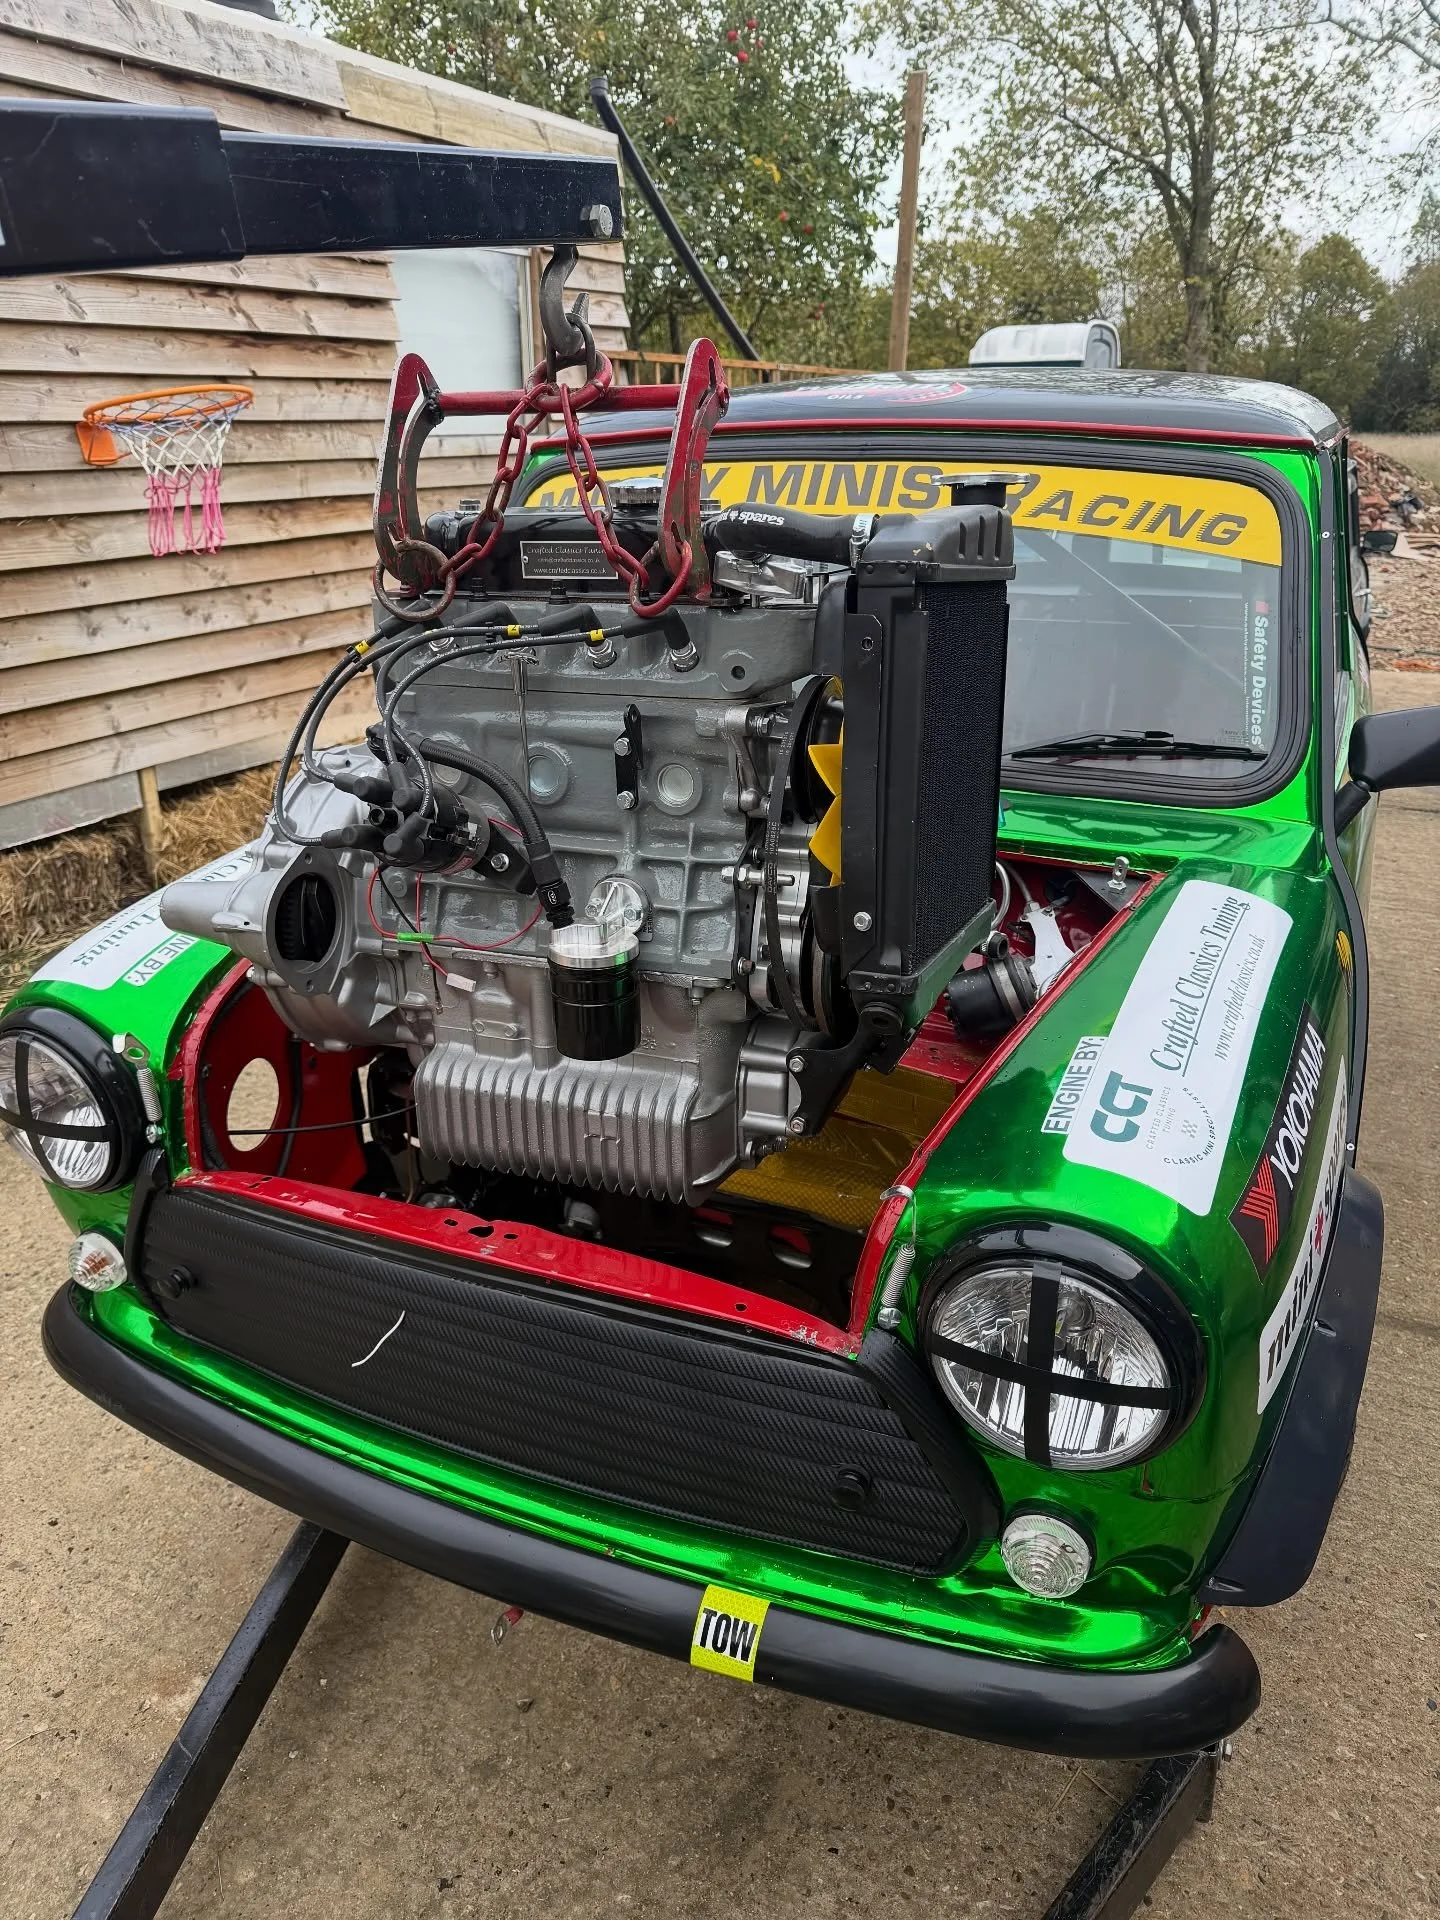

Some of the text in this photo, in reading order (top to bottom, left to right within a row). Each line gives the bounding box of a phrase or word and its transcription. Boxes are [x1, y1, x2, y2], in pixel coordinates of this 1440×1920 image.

[744, 464, 944, 510] MINIS
[739, 511, 785, 526] spares
[527, 546, 606, 555] Crafted Classics Tunin
[1251, 615, 1269, 672] Safety
[70, 911, 158, 969] Tuning
[124, 935, 195, 984] INE BY:
[1150, 896, 1251, 1072] Crafted Classics Tuning
[1214, 933, 1266, 1062] www.craftedclassics.co.uk
[1044, 1037, 1106, 1132] ENGINE BY:
[1090, 1070, 1154, 1143] CCT
[1270, 1021, 1326, 1191] YOKOHAMA
[1145, 1086, 1171, 1150] CRAFTED CLASSICS
[1162, 1107, 1176, 1134] TUNING
[1164, 1087, 1216, 1165] CLASSIC MINI SPECIALISTS
[1266, 1228, 1313, 1384] mini
[700, 1607, 759, 1662] TOW
